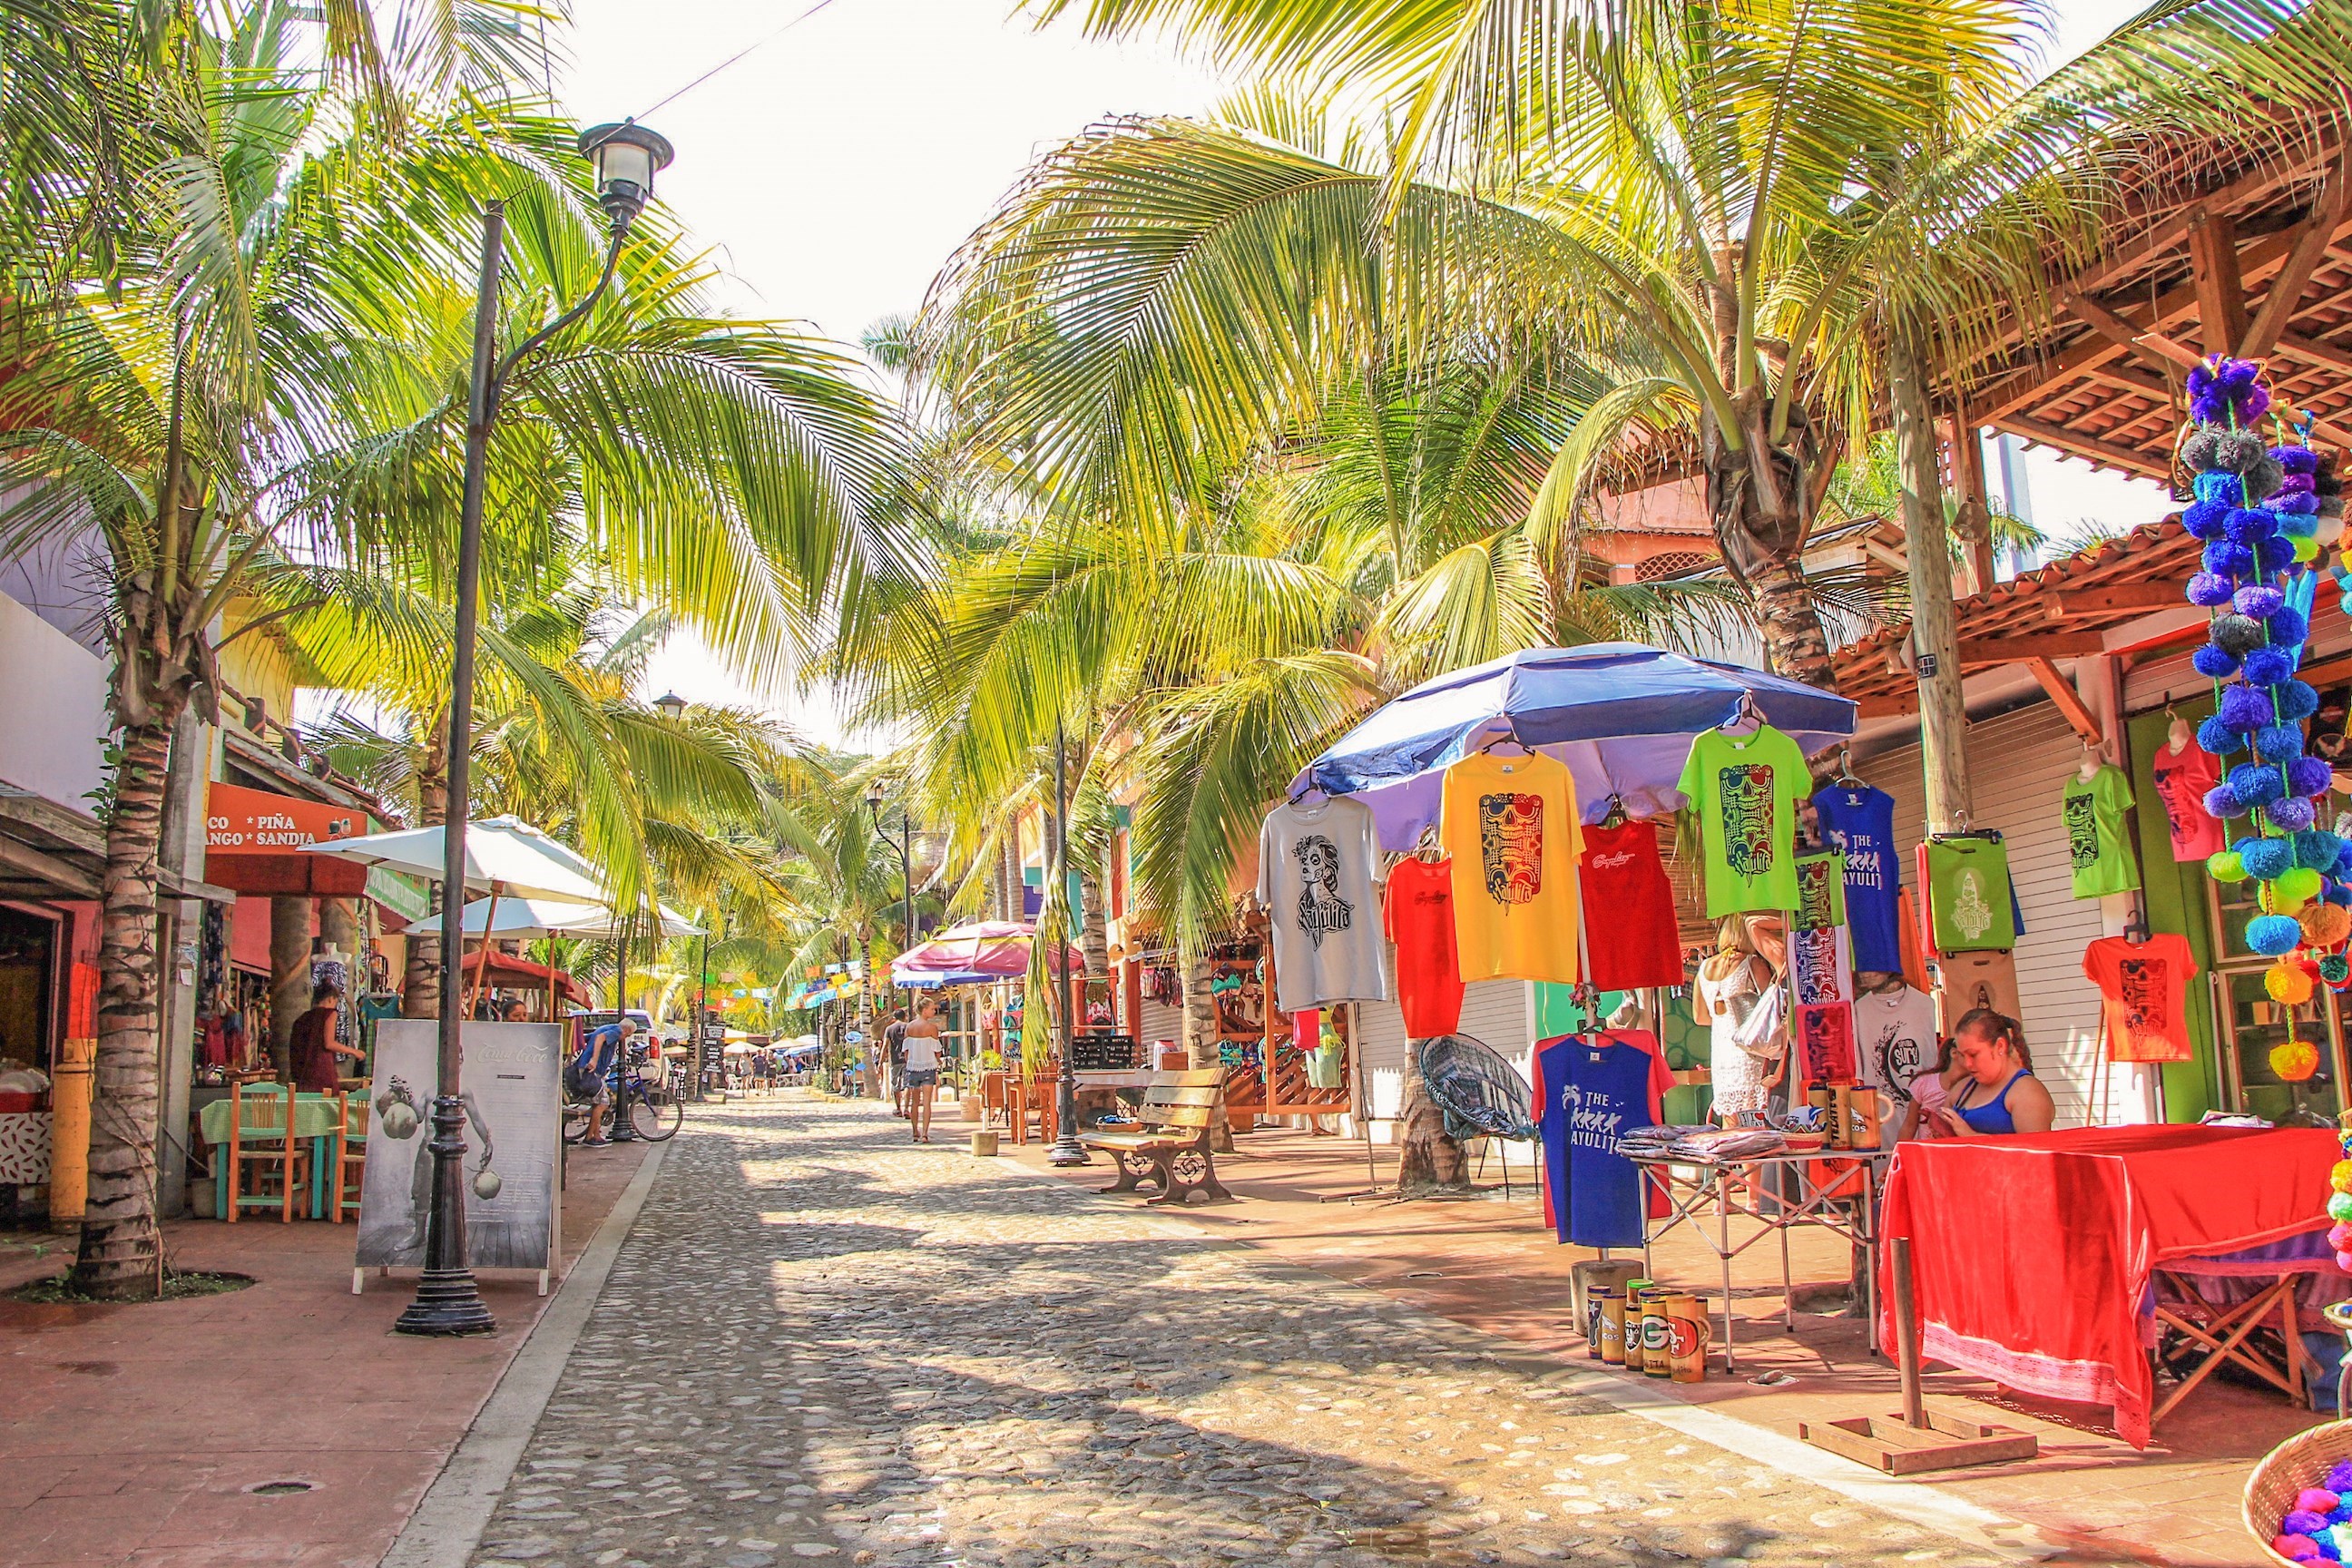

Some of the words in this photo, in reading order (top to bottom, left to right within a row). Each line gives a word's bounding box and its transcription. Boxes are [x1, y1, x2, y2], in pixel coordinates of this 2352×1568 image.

[257, 813, 296, 829] PIÑA
[256, 832, 315, 846] SANDIA
[1852, 834, 1871, 849] THE
[1585, 1092, 1610, 1107] THE
[1642, 1315, 1671, 1351] G
